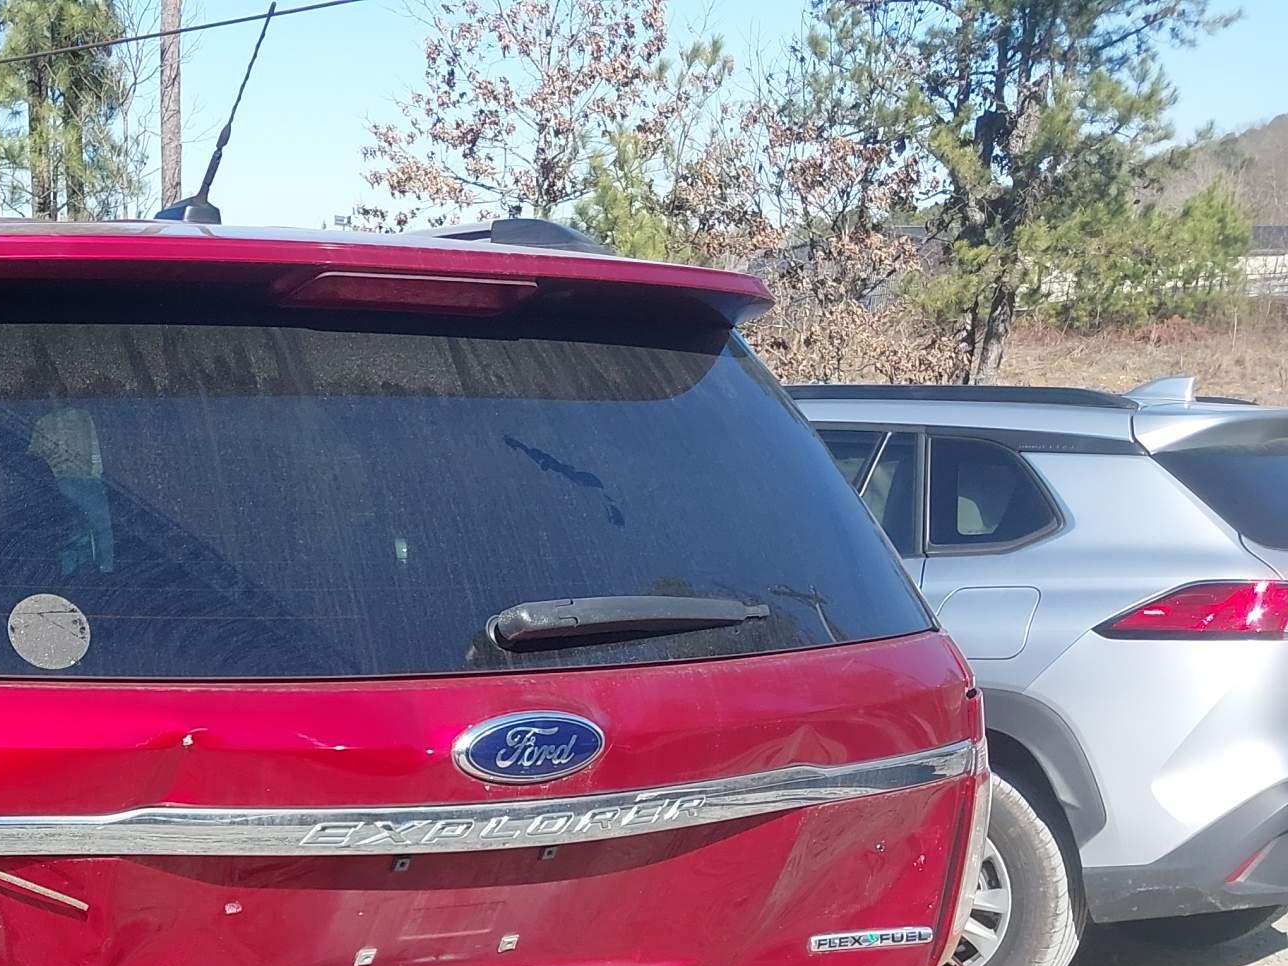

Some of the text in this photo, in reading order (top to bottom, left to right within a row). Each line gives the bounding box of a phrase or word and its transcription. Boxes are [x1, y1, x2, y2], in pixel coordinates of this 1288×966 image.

[496, 727, 578, 768] Ford
[300, 794, 707, 847] EXPLORER
[816, 931, 929, 949] FLEX FUEL
